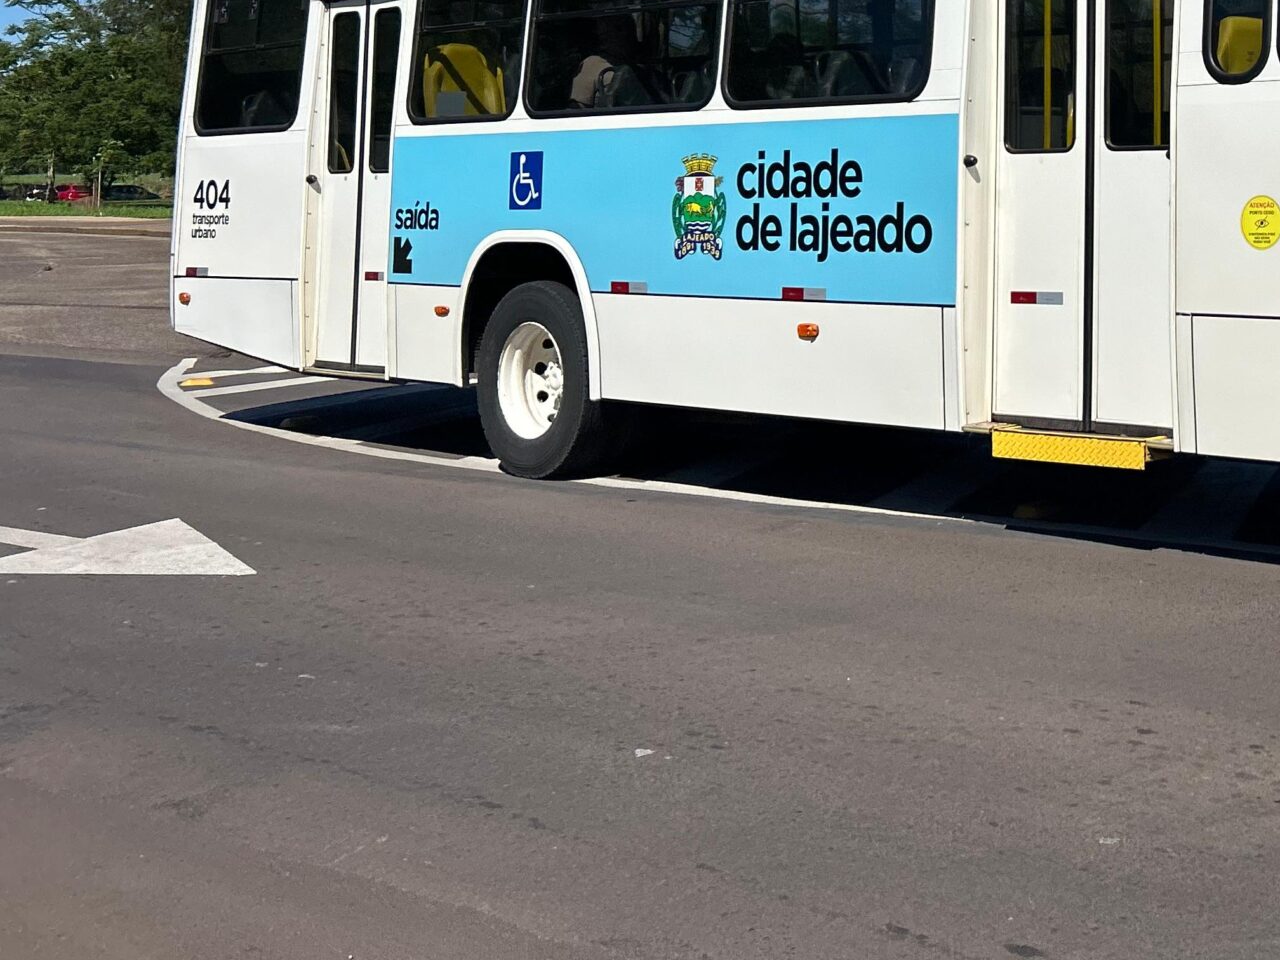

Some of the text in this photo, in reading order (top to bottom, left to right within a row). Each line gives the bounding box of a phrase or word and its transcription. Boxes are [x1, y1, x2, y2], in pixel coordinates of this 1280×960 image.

[737, 148, 863, 199] cidade
[193, 179, 231, 210] 404
[192, 213, 230, 227] transporte
[394, 199, 439, 231] saída
[191, 226, 216, 239] urbano
[682, 232, 715, 242] LAJEADO
[736, 201, 933, 263] de lajeado
